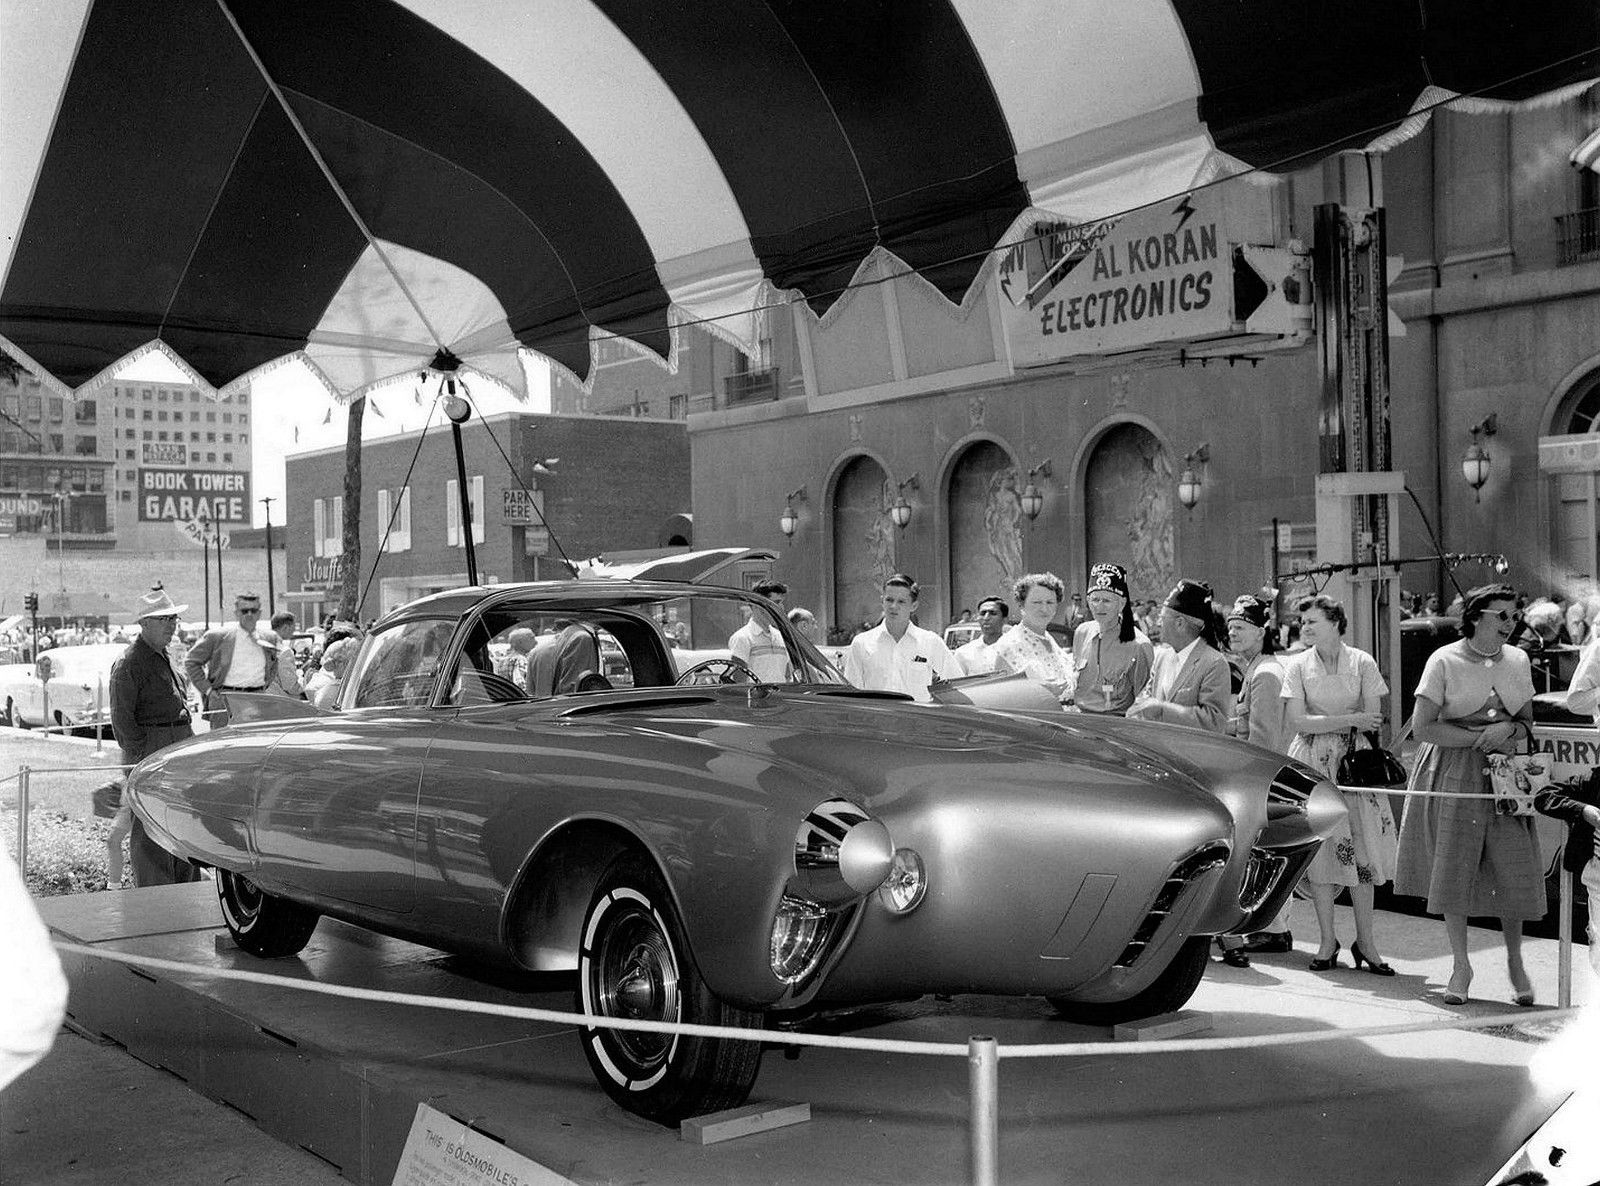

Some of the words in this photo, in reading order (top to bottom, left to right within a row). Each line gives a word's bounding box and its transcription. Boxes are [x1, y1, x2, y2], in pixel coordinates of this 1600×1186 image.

[1092, 245, 1122, 281] AL
[1128, 223, 1218, 276] KORAN
[1041, 271, 1213, 336] ELECTRONICS
[144, 472, 188, 490] BOOK
[192, 474, 245, 491] TOWER
[146, 495, 243, 519] GARAGE
[504, 505, 530, 518] HERE
[426, 1129, 443, 1148] THIS
[446, 1143, 454, 1155] IS
